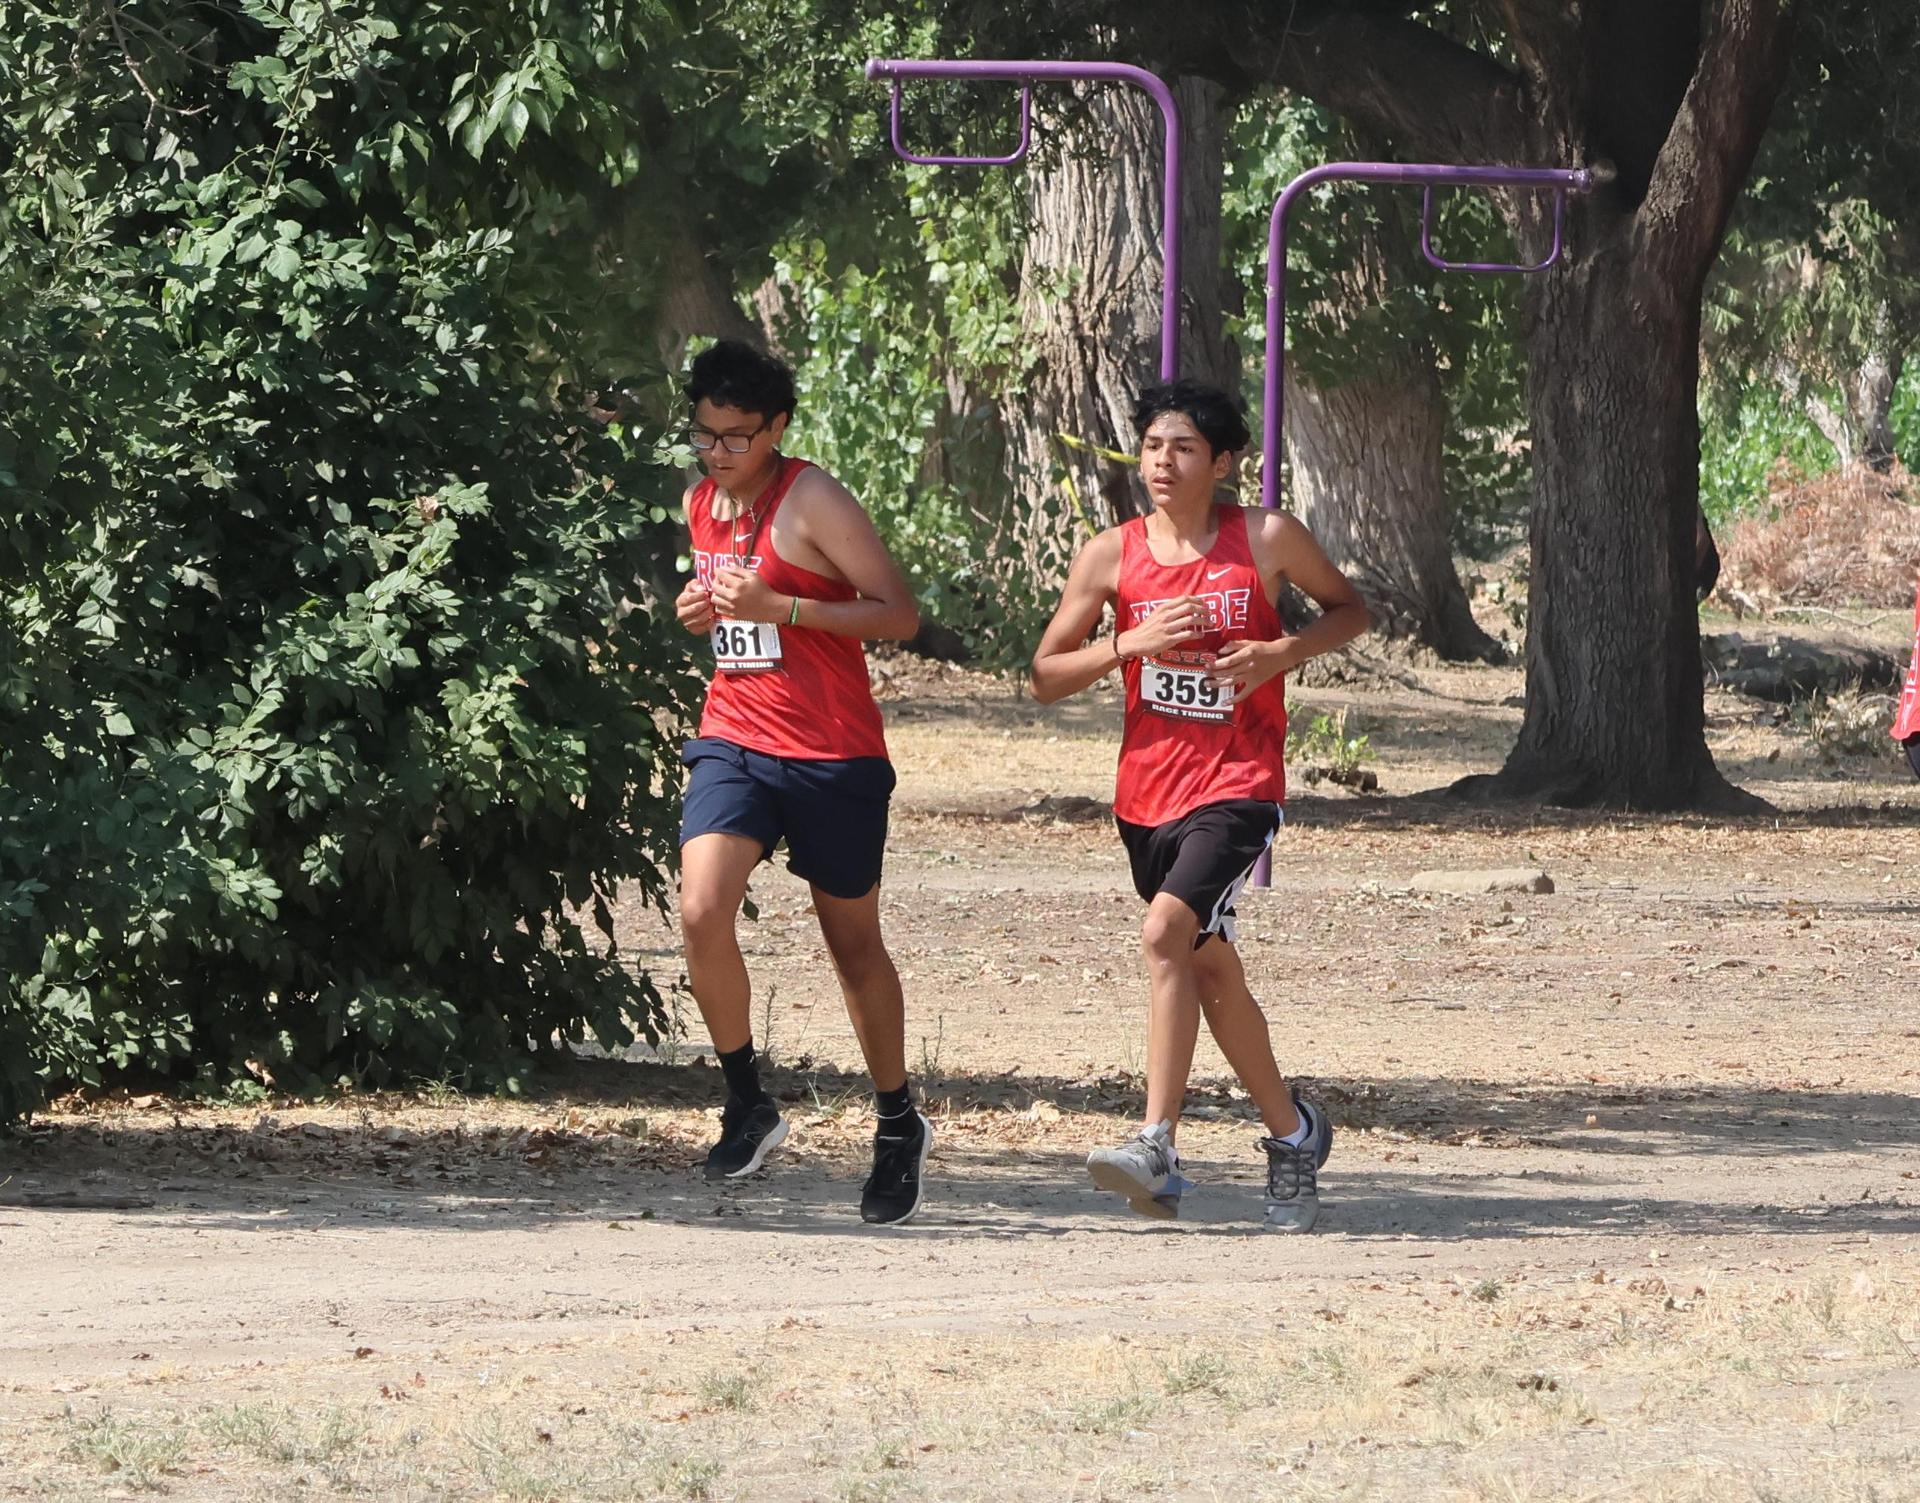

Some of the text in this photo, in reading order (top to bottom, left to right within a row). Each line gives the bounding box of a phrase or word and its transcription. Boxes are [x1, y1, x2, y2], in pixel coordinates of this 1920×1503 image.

[1130, 588, 1250, 633] TBE
[716, 625, 762, 657] 361
[737, 661, 774, 669] TIMING
[1155, 672, 1219, 707] 359
[1152, 703, 1224, 720] RACE TIMING
